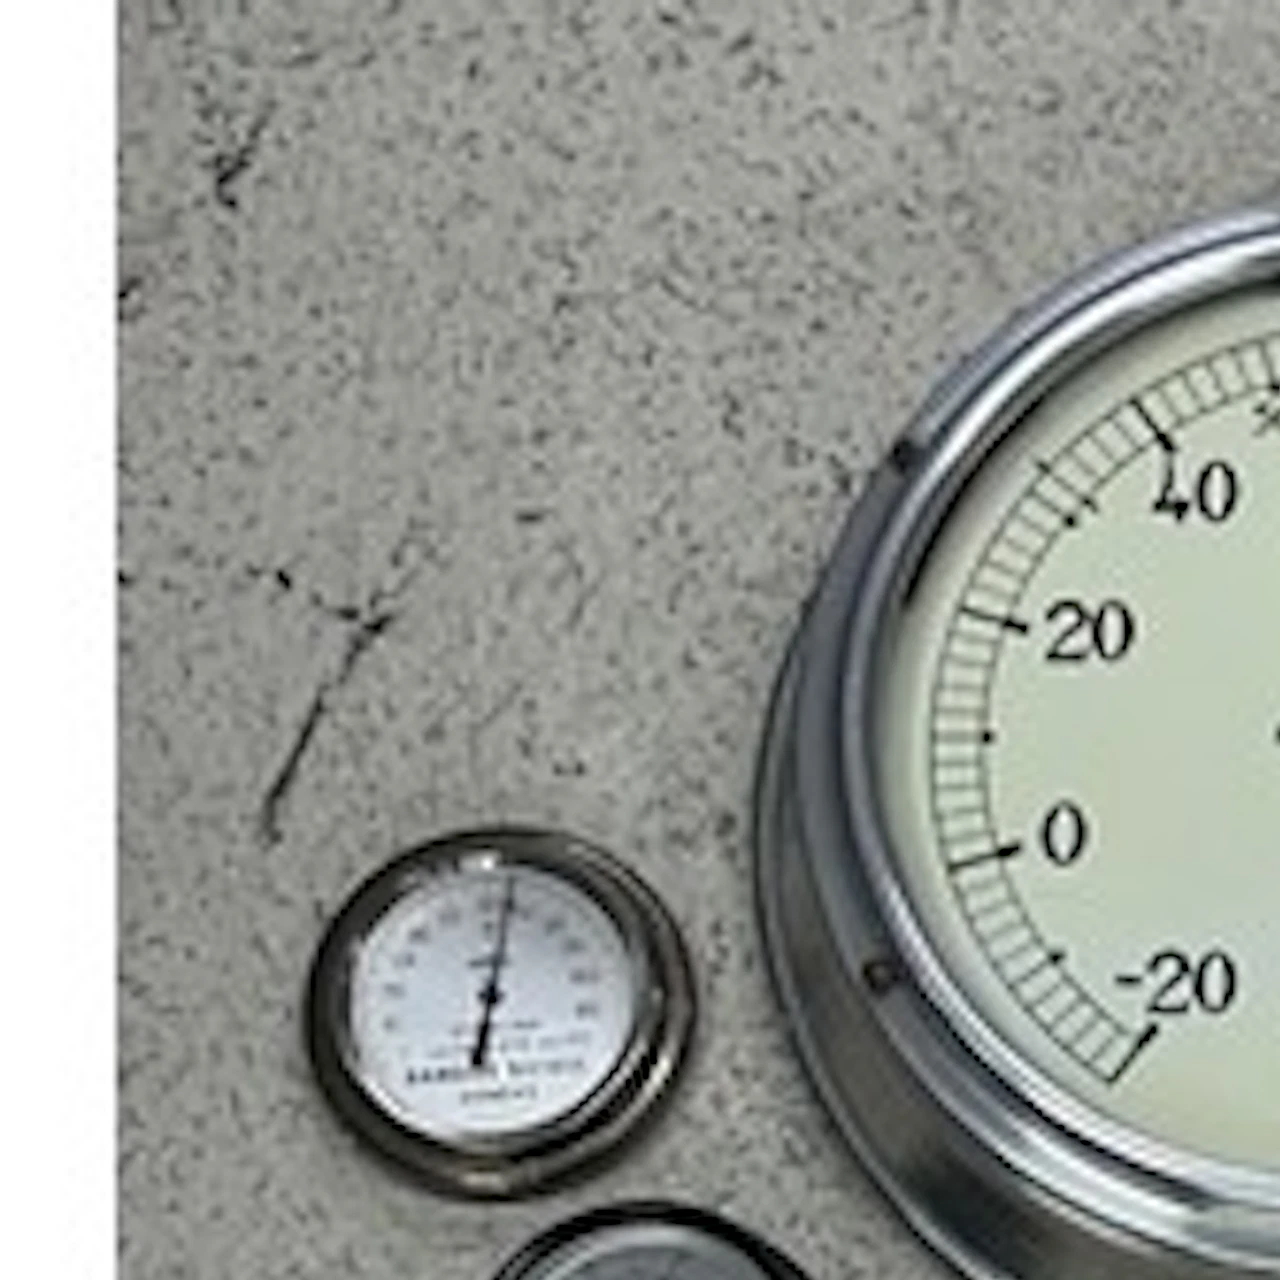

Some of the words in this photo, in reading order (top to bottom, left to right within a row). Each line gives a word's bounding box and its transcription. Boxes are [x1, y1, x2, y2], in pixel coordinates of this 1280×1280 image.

[1152, 457, 1239, 523] 40
[1043, 601, 1134, 661] 20
[1039, 800, 1086, 866] 0
[1112, 952, 1239, 1013] -20
